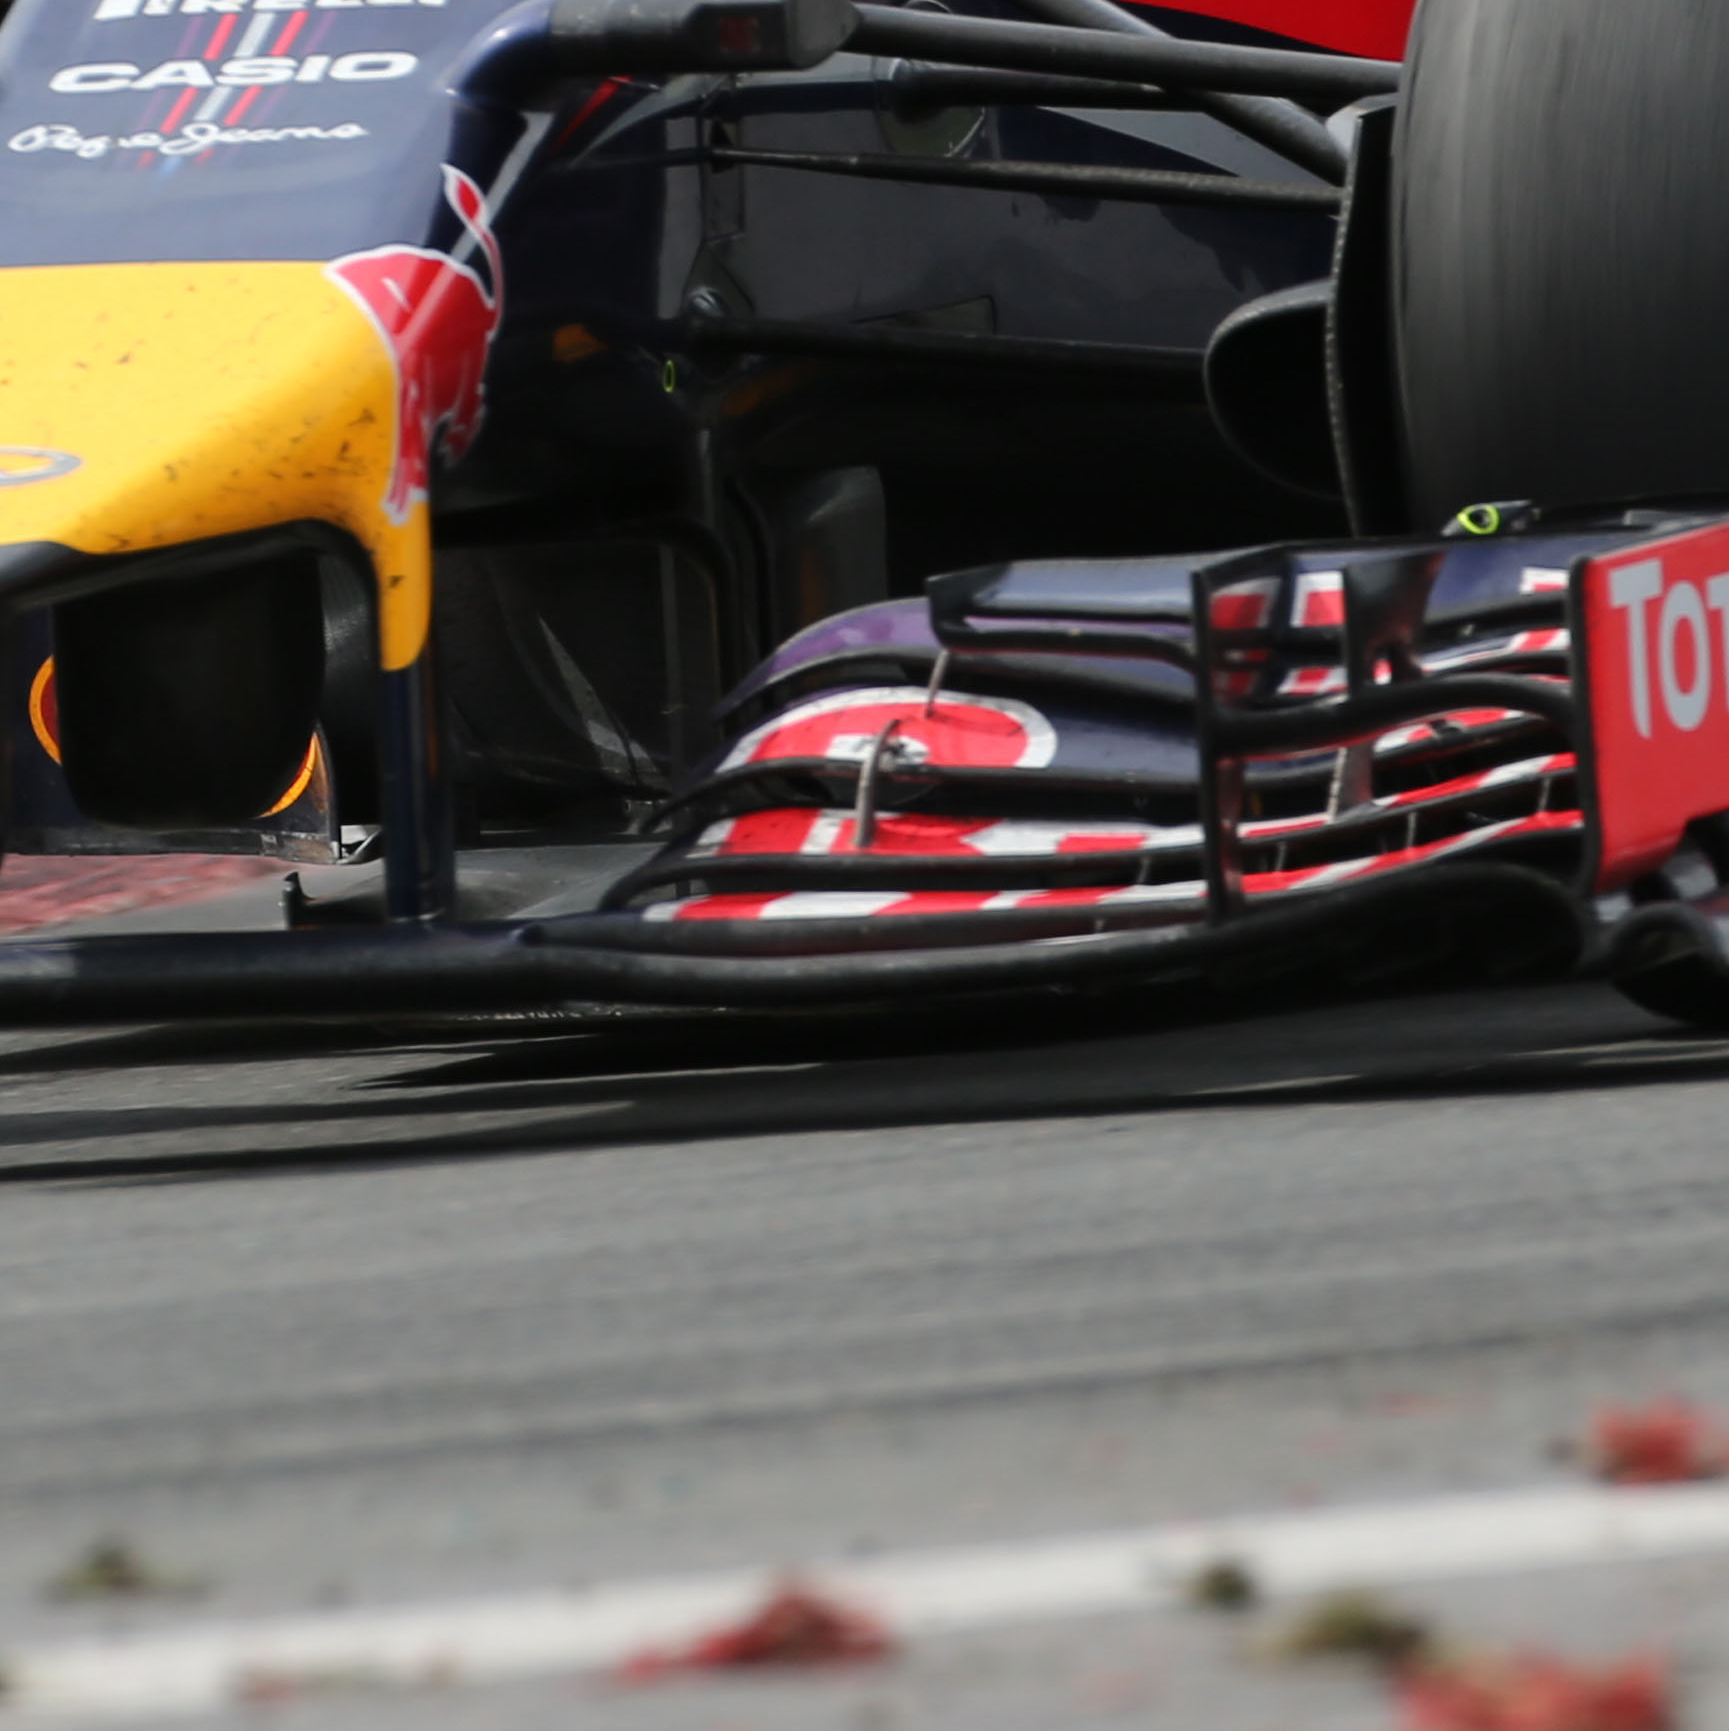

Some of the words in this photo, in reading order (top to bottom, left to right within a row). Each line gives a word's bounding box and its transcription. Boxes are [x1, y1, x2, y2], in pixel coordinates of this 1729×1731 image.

[48, 51, 419, 94] CASIO
[8, 124, 163, 159] Pepe
[157, 122, 370, 156] Jeans
